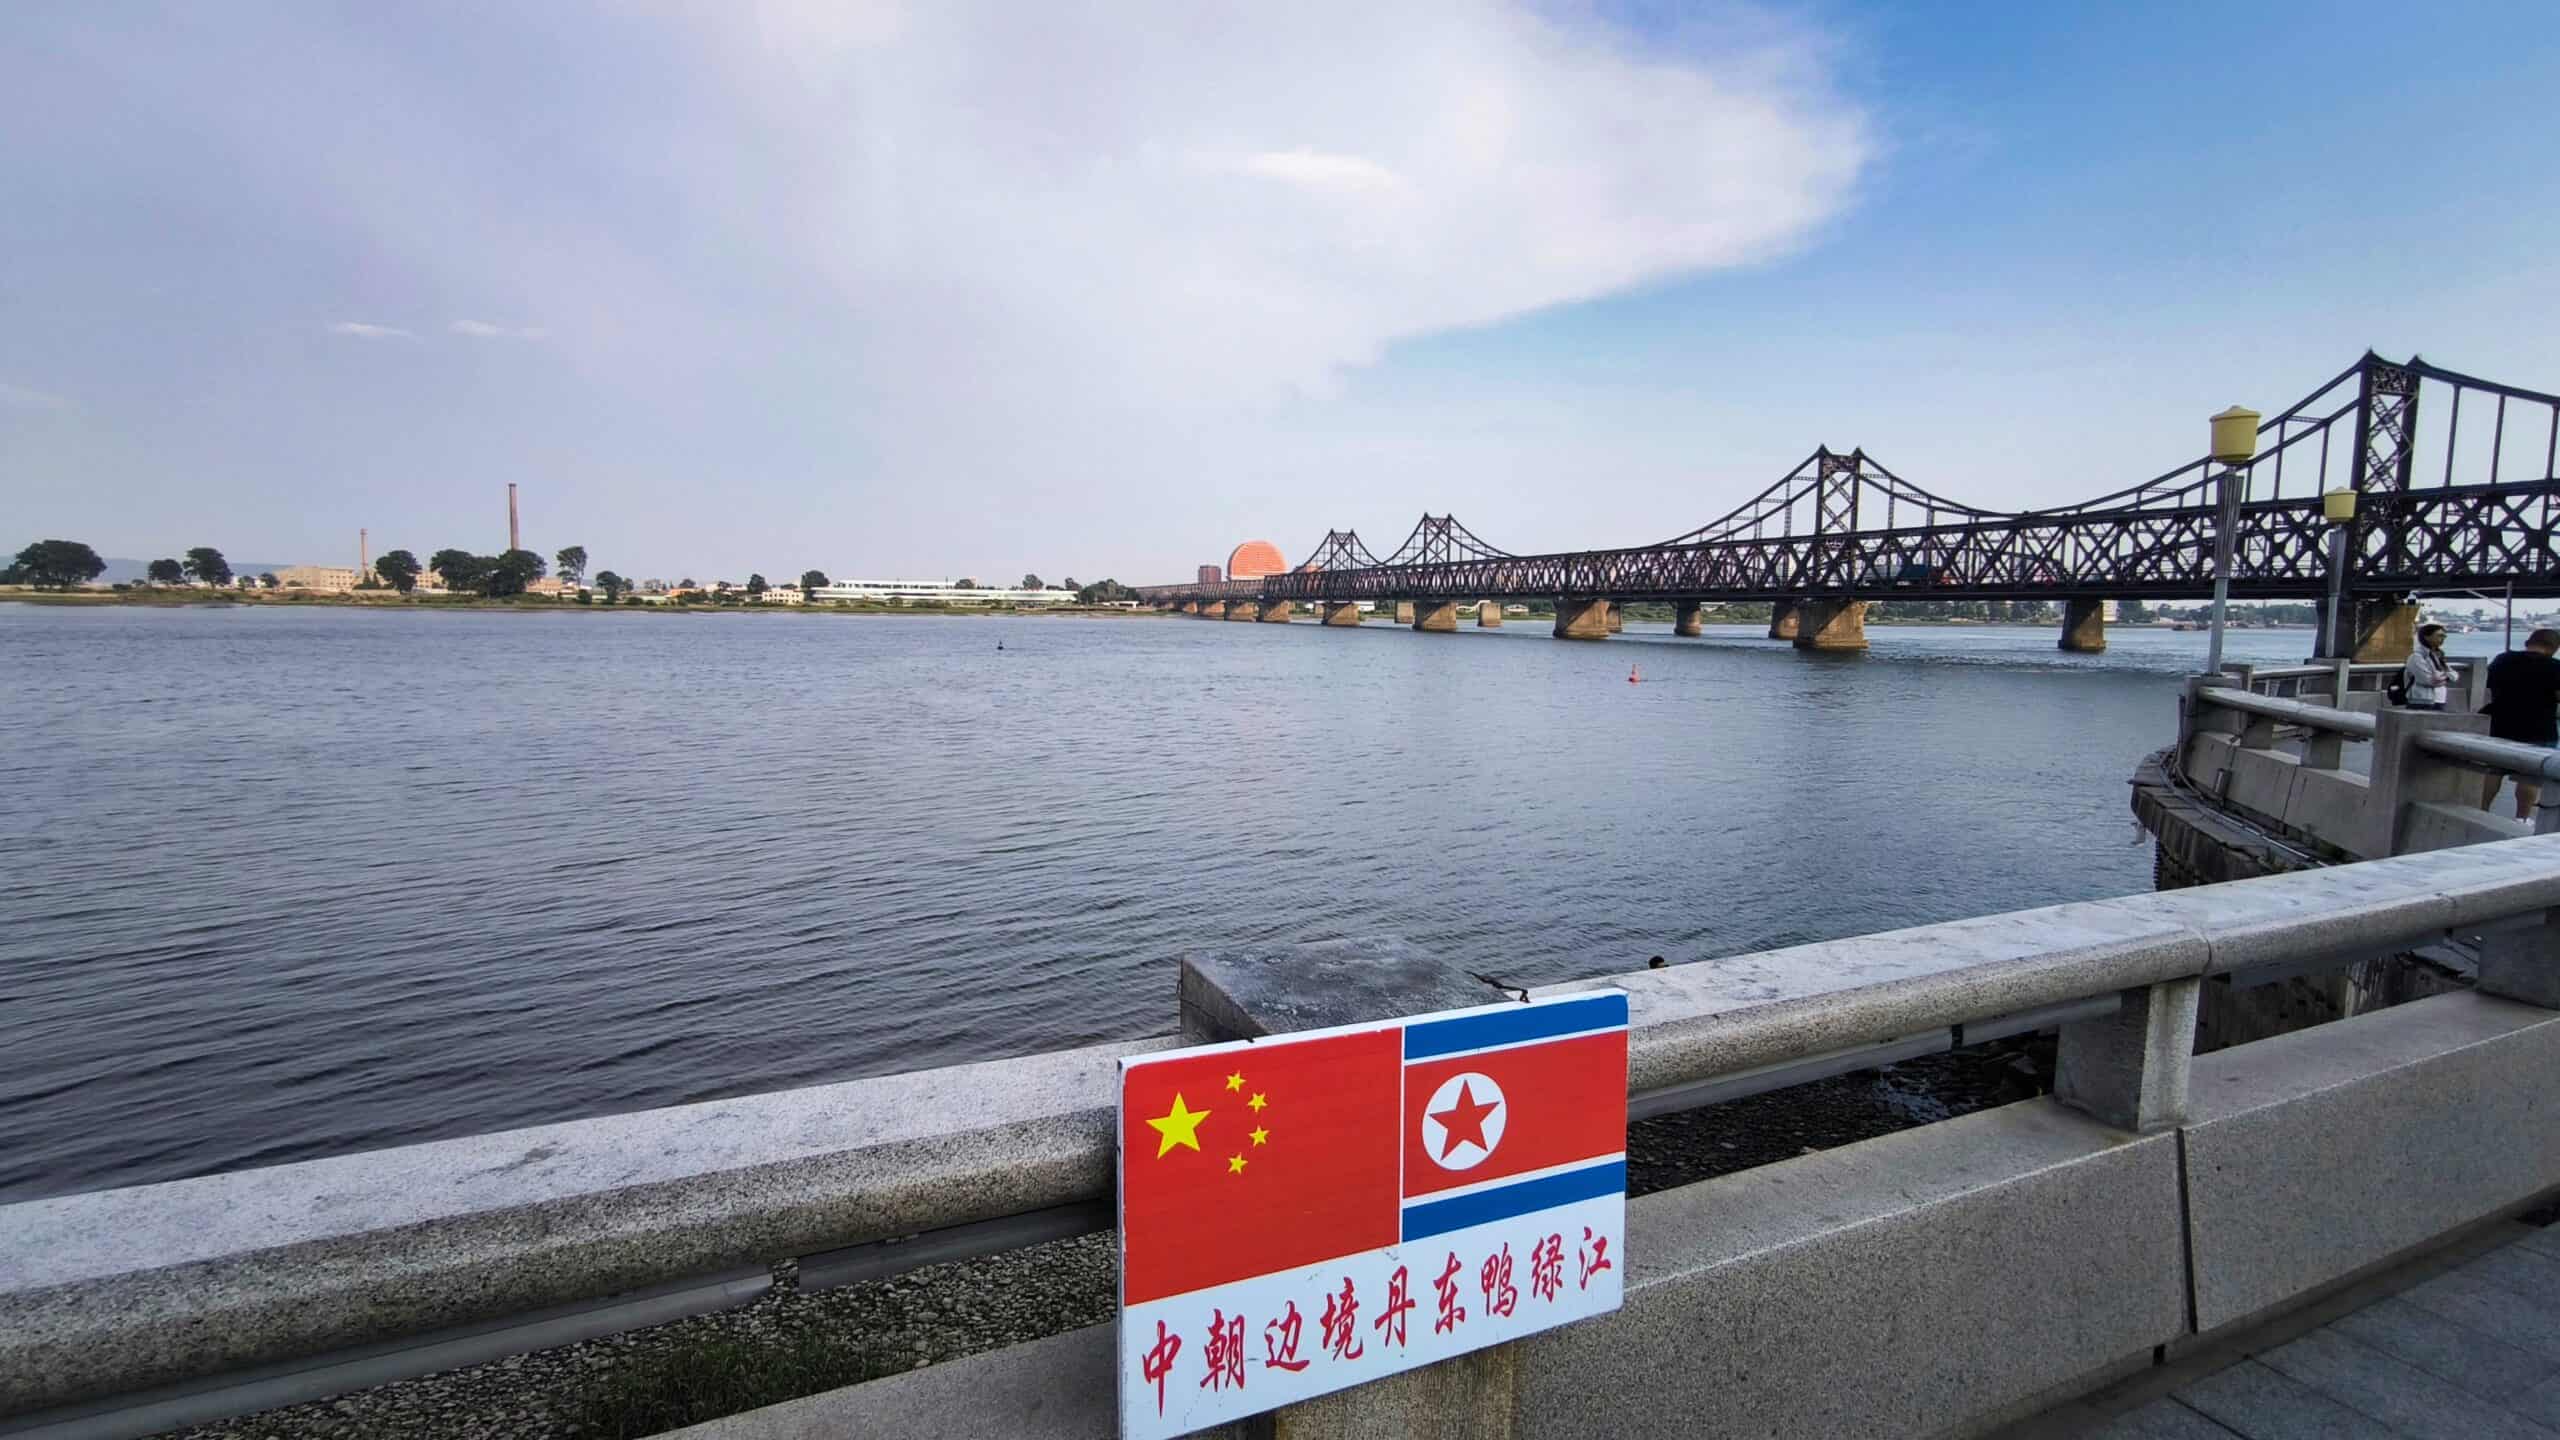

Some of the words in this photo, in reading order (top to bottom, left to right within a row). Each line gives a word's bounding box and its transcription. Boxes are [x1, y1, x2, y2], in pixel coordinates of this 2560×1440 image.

[1142, 1226, 1612, 1417] 中朝边境丹东鸭绿江
